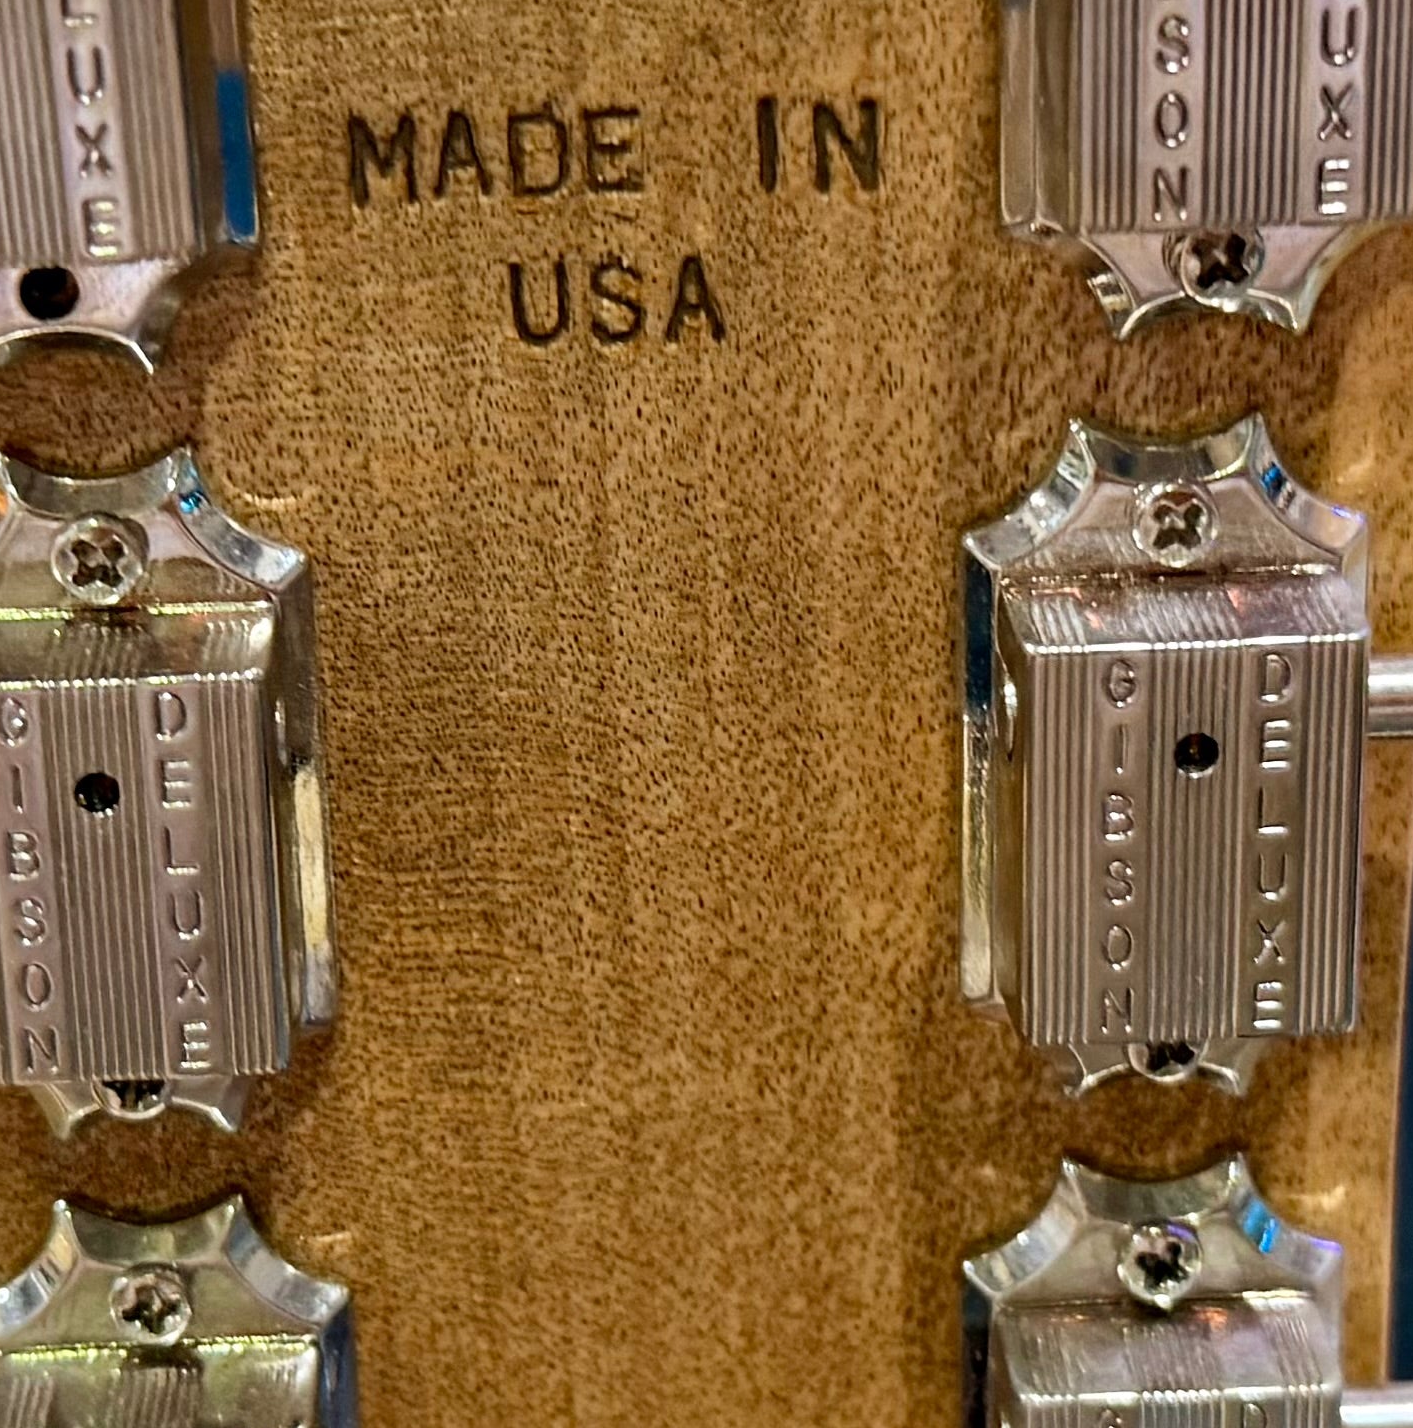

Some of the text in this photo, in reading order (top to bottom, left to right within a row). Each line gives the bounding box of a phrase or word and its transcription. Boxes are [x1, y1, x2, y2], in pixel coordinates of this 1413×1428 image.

[347, 95, 881, 208] MADE IN
[508, 255, 727, 346] USA
[153, 689, 213, 1071] DELUXE
[1101, 658, 1137, 1036] GIBSON
[1252, 651, 1291, 1032] DELUXE
